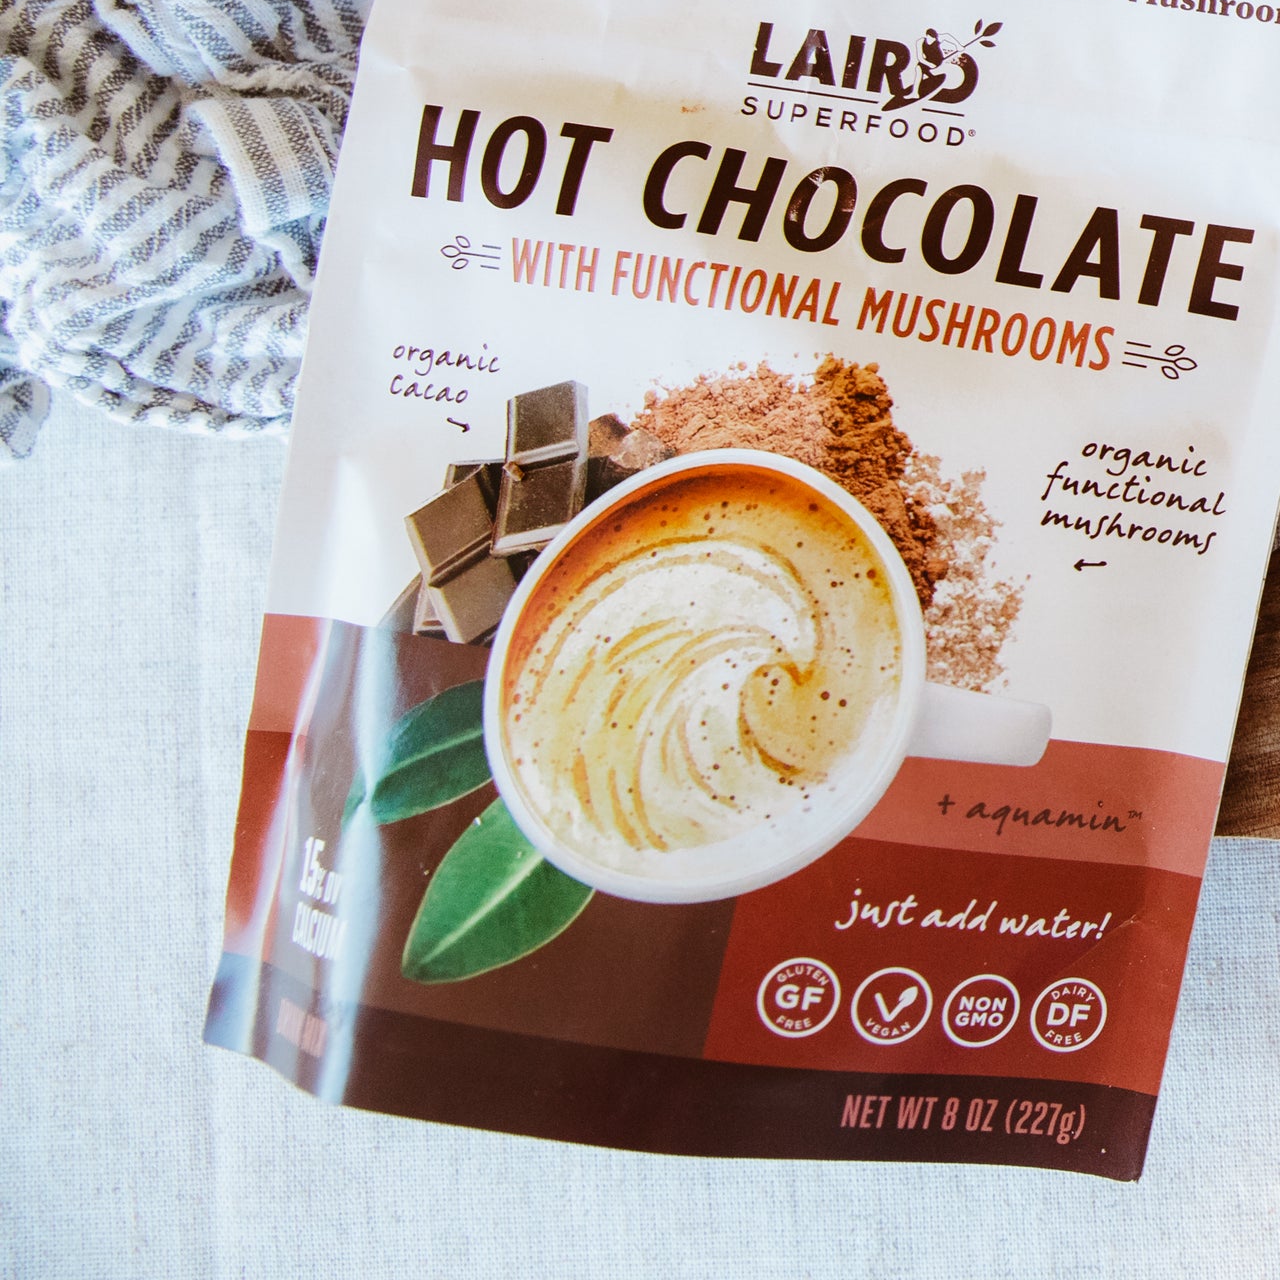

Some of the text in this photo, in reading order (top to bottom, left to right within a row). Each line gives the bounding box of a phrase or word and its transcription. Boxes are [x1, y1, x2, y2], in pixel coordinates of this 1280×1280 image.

[750, 21, 979, 106] LAIRD
[410, 105, 1256, 321] HOT CHOCOLATE
[510, 236, 1117, 371] WITH FUNCTIONAL MUSHROOMS
[393, 343, 500, 376] organic
[1082, 443, 1208, 476] organic
[1041, 461, 1226, 515] functional
[1040, 510, 1217, 555] mushrooms
[834, 888, 1112, 940] just add water!
[776, 965, 829, 986] GLUTEN
[775, 984, 825, 1011] GF
[959, 996, 1007, 1011] NON
[1051, 985, 1095, 1003] DAIRY
[776, 1015, 812, 1030] FREE
[866, 1018, 911, 1037] VEGAN
[955, 1012, 1004, 1027] GMO
[1047, 1002, 1091, 1027] DF
[1045, 1030, 1083, 1045] FREE
[840, 1094, 1086, 1144] NET WT 8 OZ (227g)
